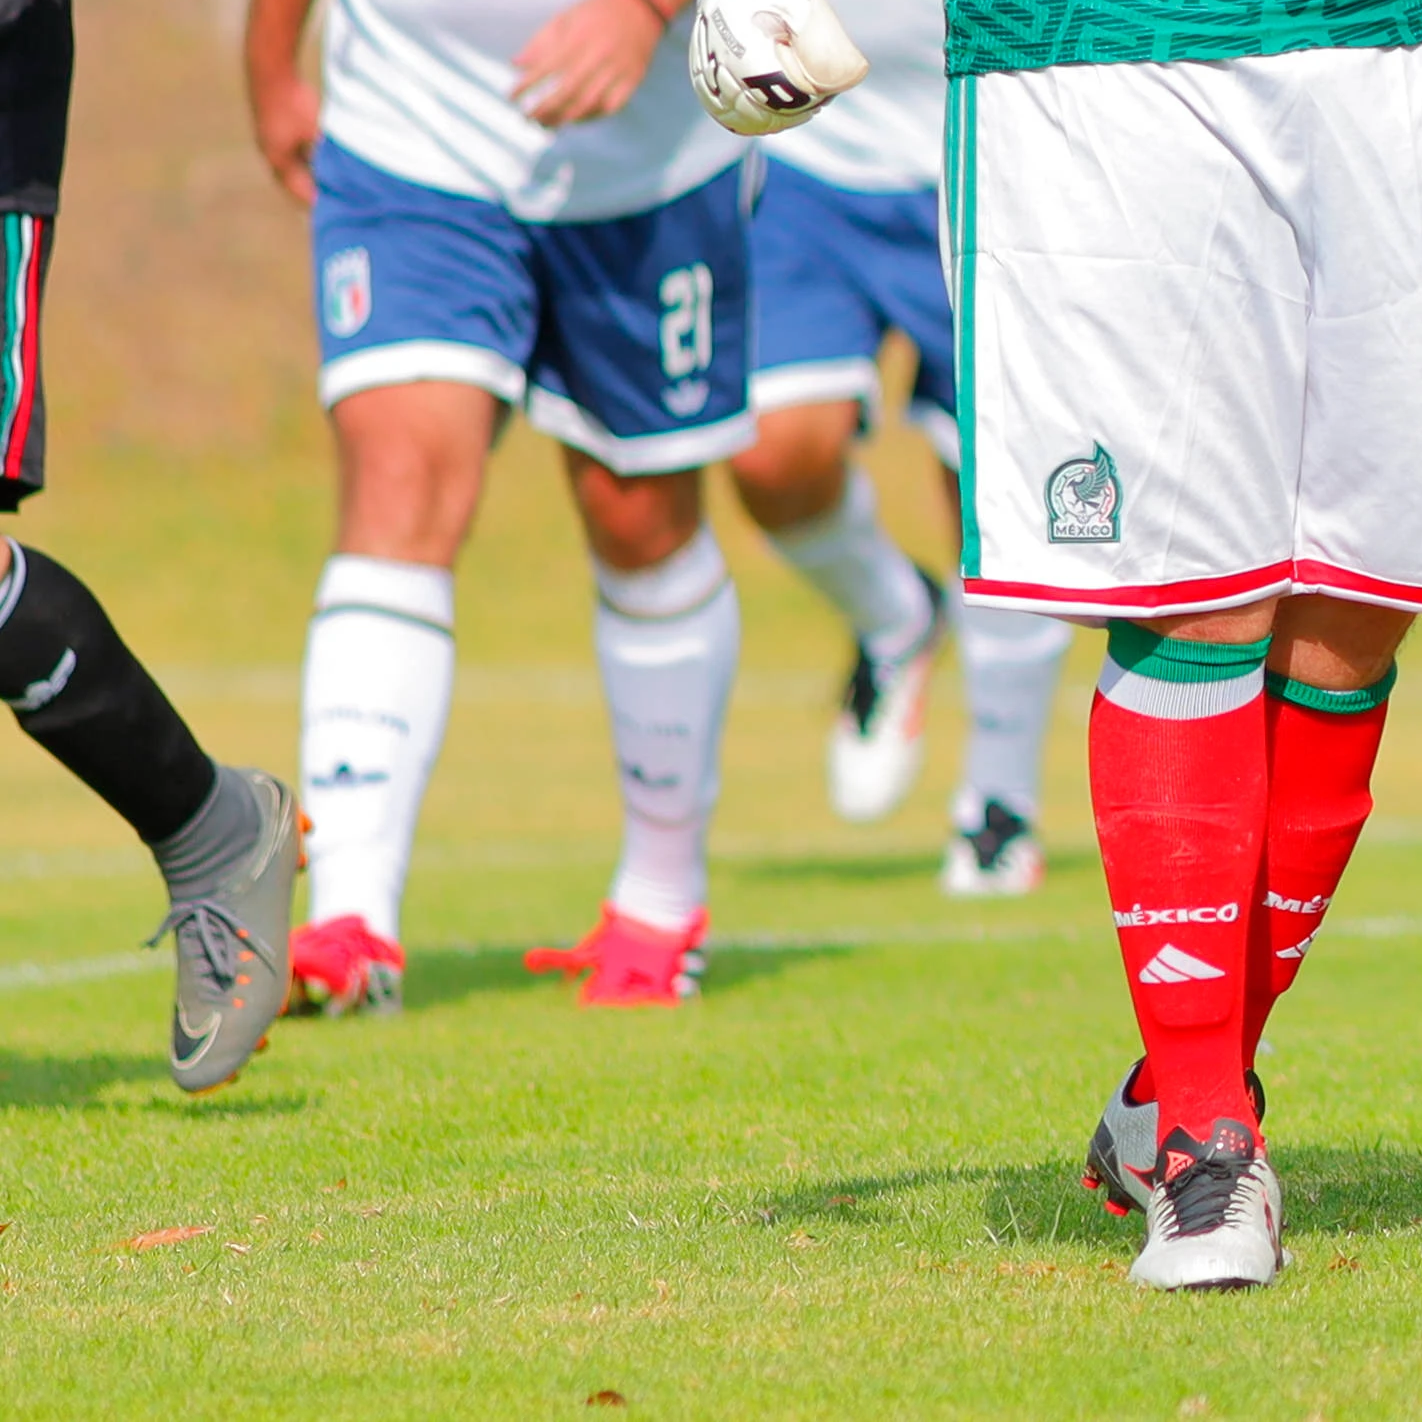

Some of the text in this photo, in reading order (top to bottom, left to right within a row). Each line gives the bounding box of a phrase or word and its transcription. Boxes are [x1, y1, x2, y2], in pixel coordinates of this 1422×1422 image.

[658, 261, 714, 378] 21
[1055, 523, 1111, 536] MÉXICO
[1113, 903, 1240, 927] MÉXICO
